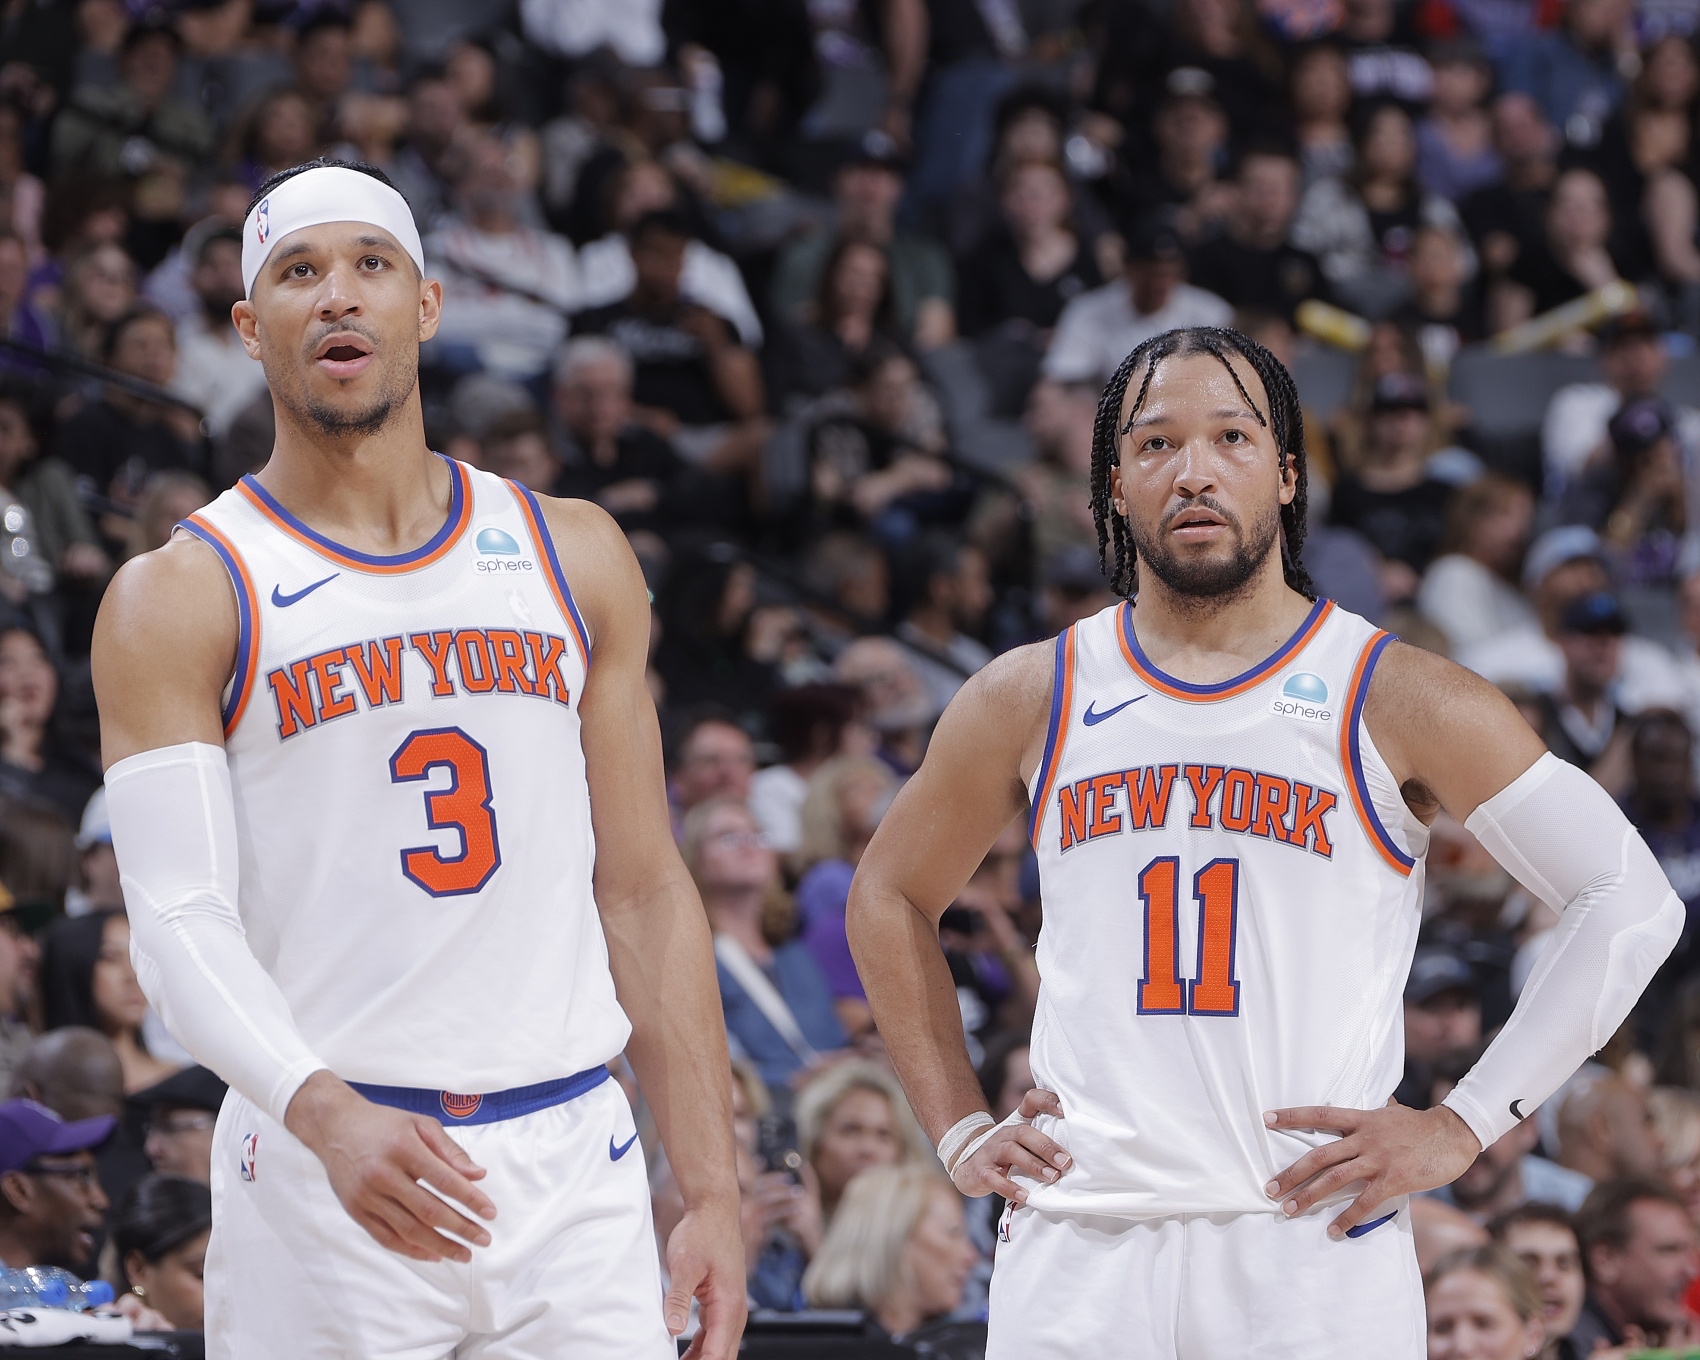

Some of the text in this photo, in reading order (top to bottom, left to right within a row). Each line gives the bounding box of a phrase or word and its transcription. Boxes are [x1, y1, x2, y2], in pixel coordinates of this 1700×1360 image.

[476, 558, 533, 573] sphere
[266, 627, 570, 742] NEW YORK
[1273, 701, 1331, 721] sphere
[388, 726, 502, 898] 3
[1058, 762, 1338, 861] NEW YORK
[1137, 855, 1241, 1017] 11
